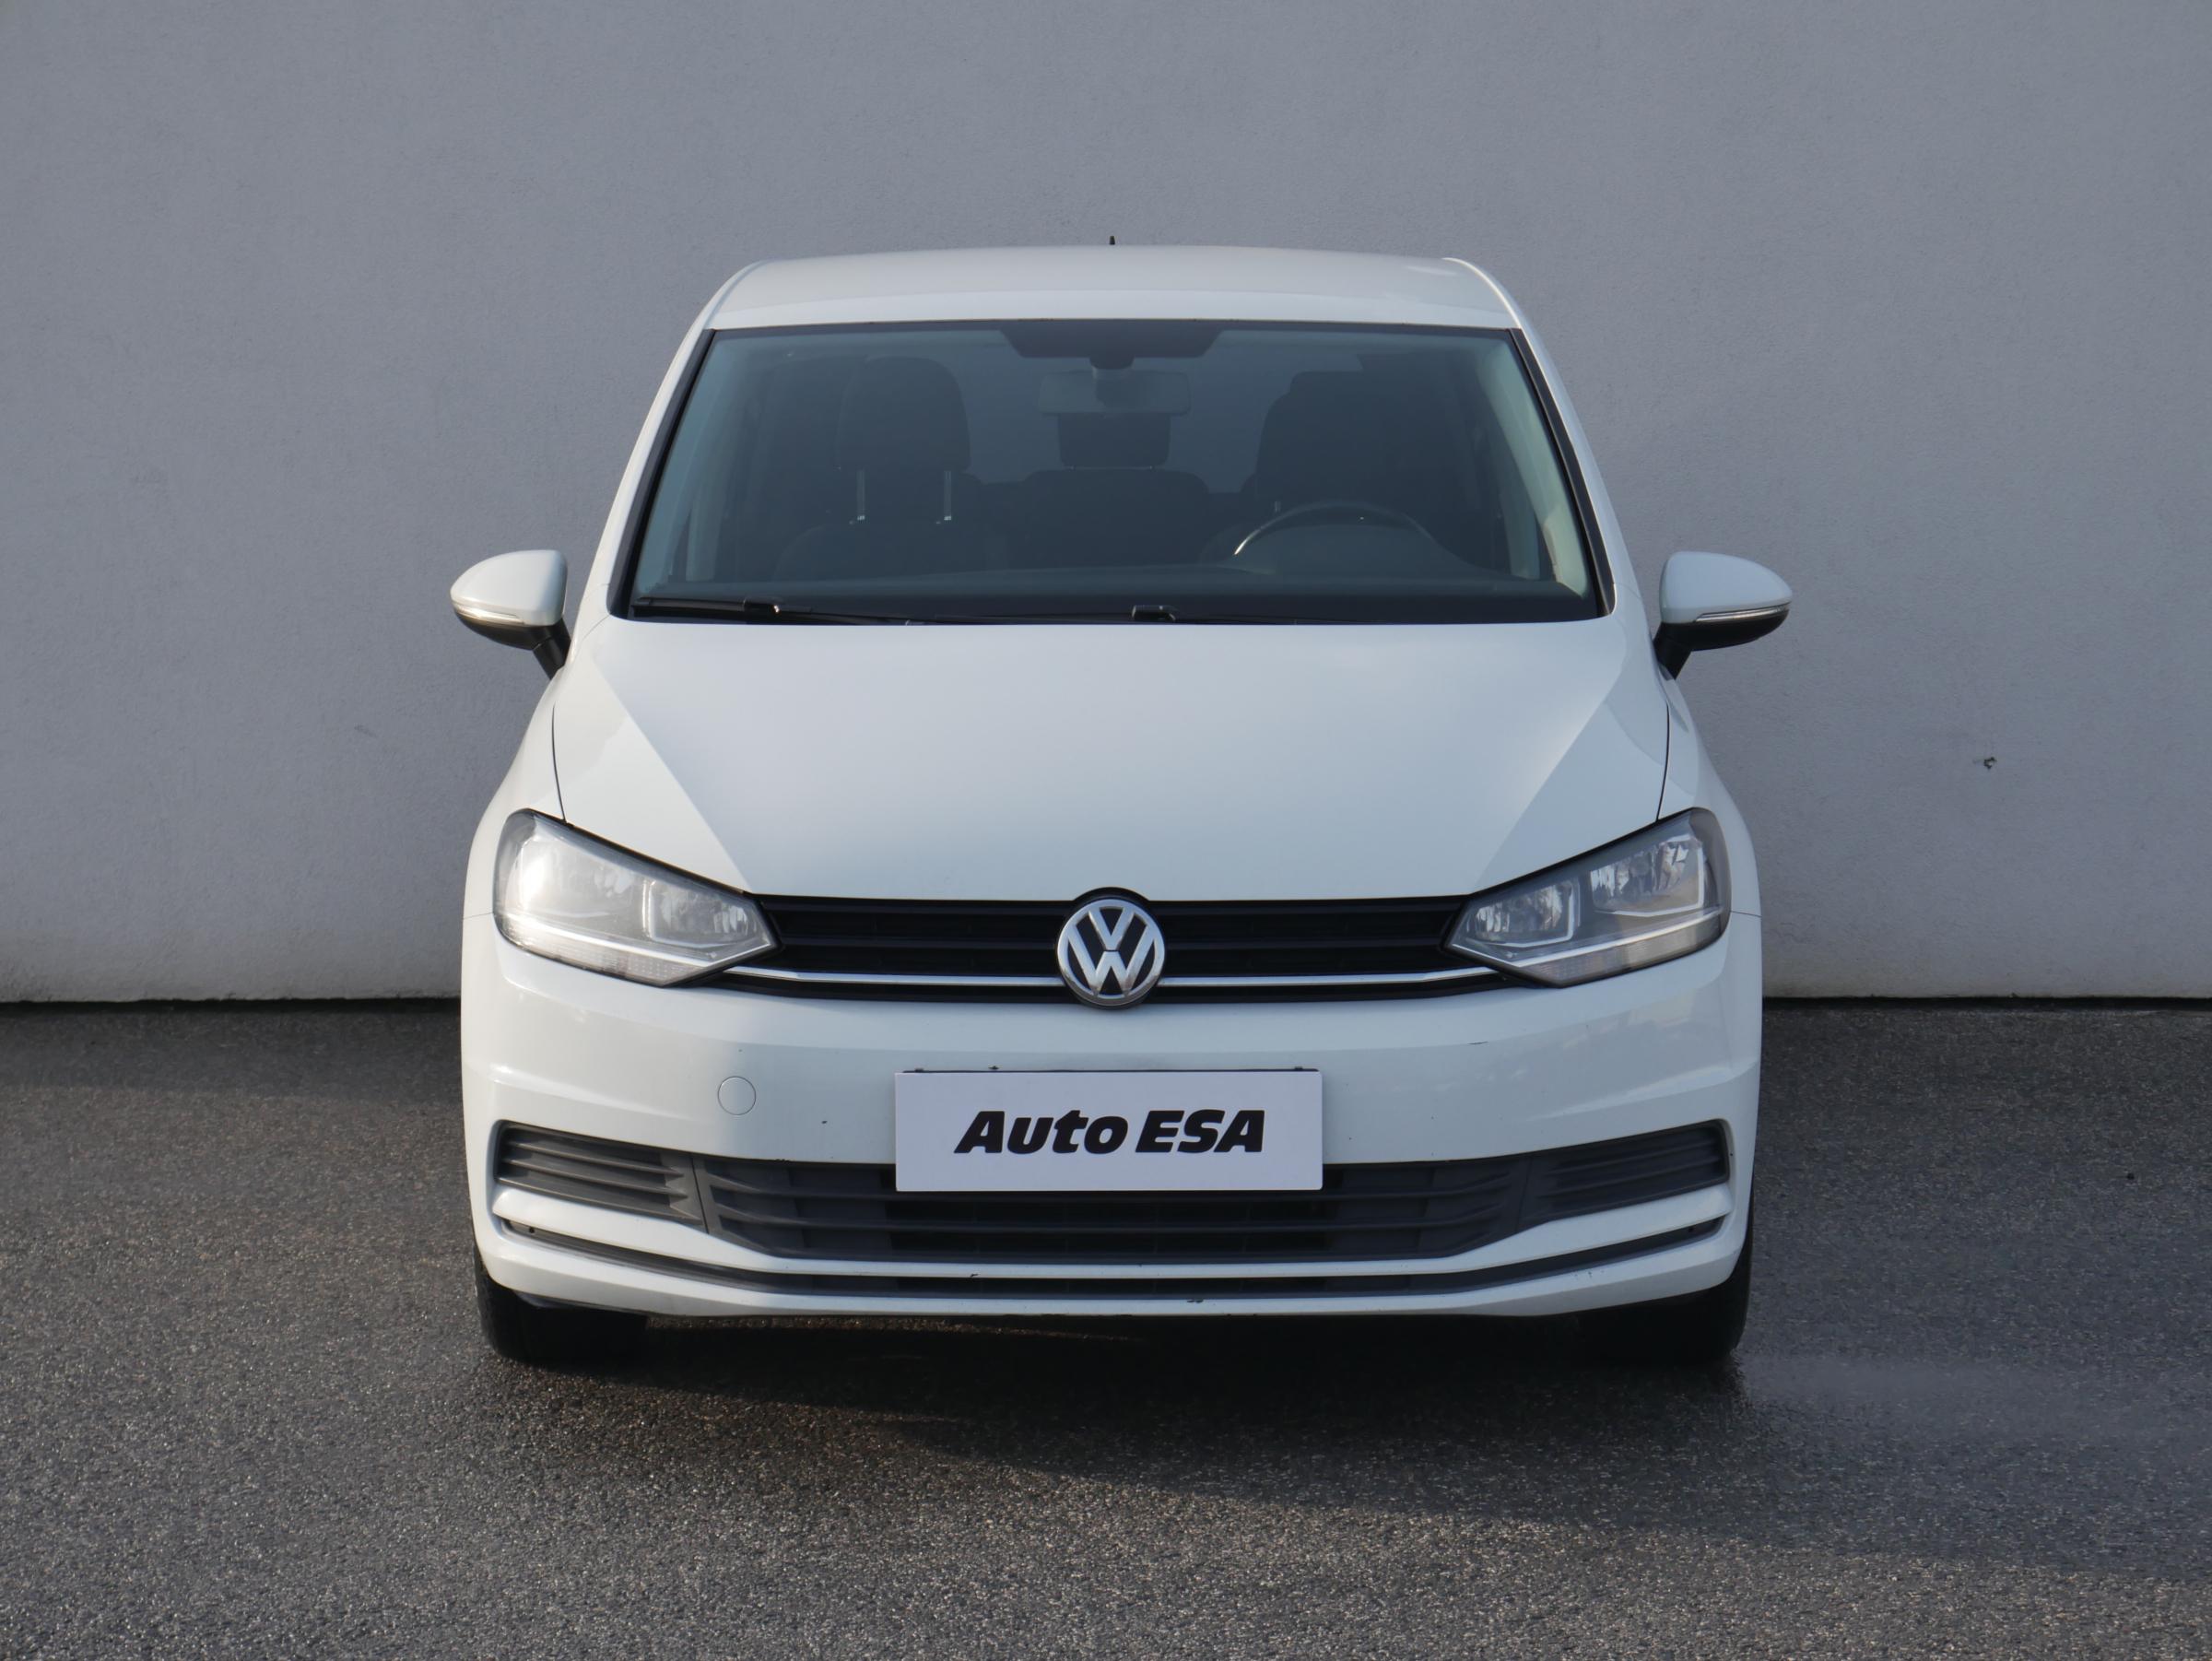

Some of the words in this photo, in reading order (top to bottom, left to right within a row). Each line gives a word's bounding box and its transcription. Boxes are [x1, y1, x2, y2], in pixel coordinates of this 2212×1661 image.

[1062, 902, 1160, 1000] VW
[953, 1109, 1129, 1154] Auto
[1135, 1108, 1265, 1154] ESA
